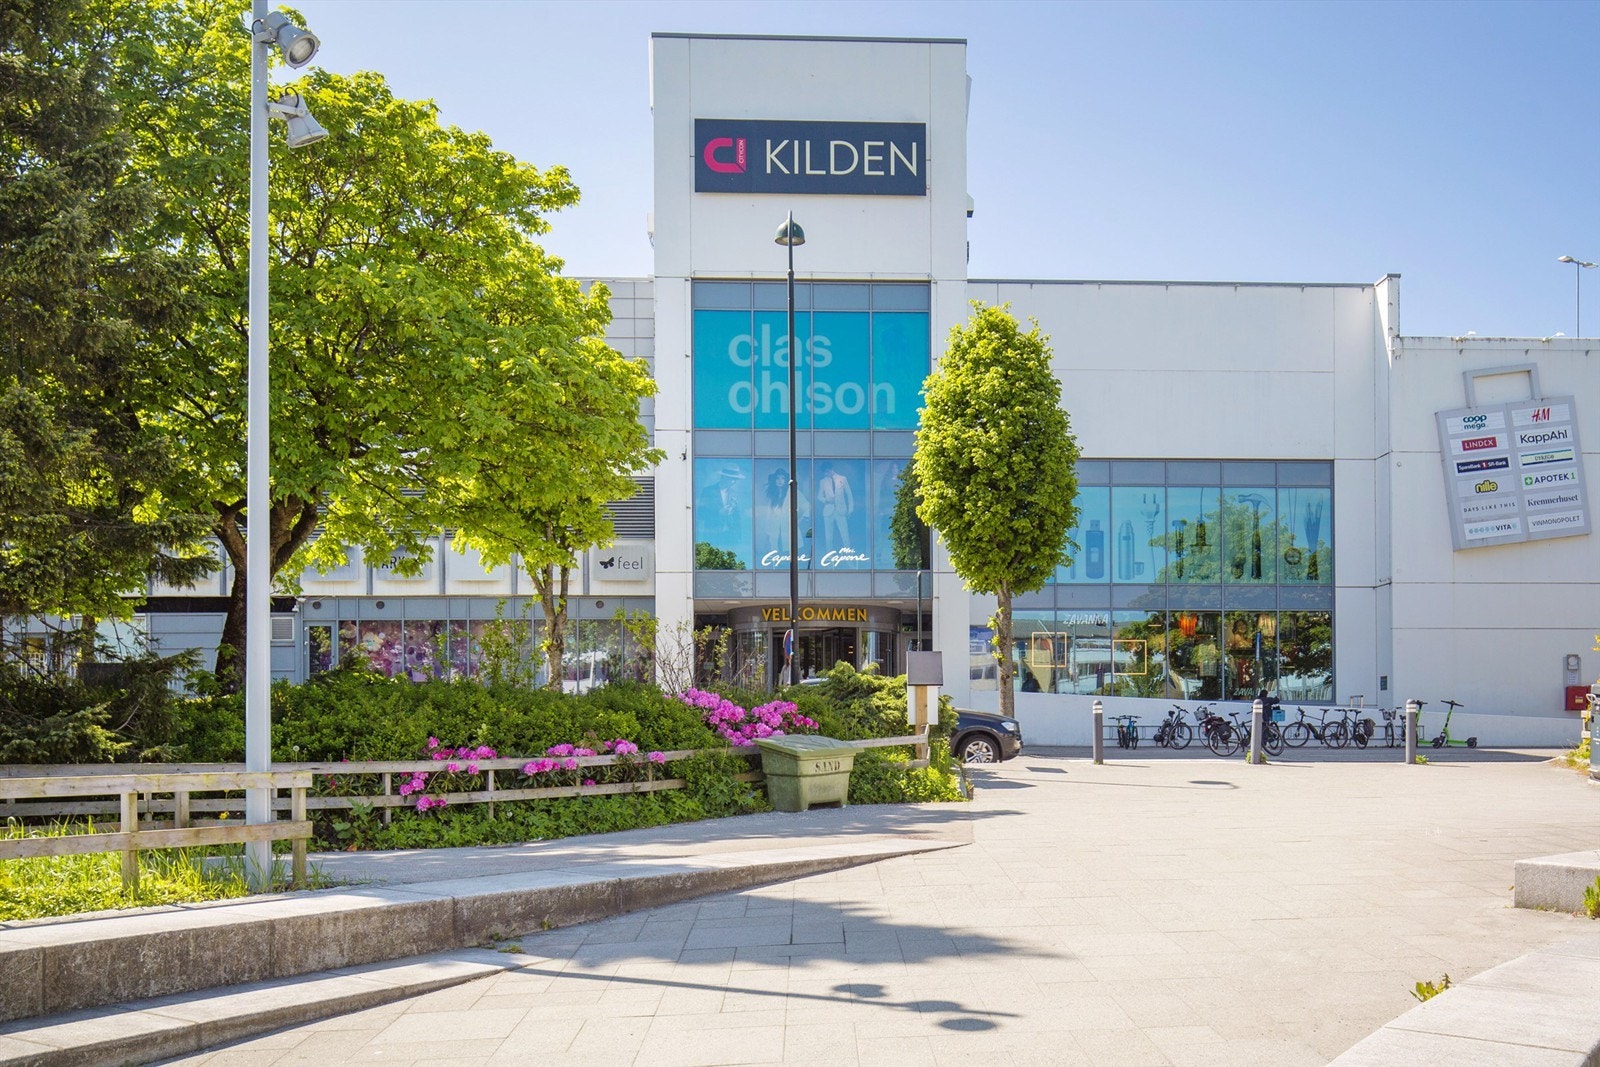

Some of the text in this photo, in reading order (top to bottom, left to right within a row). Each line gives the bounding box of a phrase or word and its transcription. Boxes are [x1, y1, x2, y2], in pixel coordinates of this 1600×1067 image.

[765, 139, 917, 177] KILDEN
[728, 324, 833, 368] clas
[728, 371, 896, 415] ohlson
[1462, 414, 1487, 423] coop
[1531, 407, 1551, 423] H&M
[1463, 422, 1486, 430] mega
[1520, 429, 1568, 444] KappAhl
[1464, 438, 1494, 449] LINDEX
[1534, 474, 1570, 484] APOTEK
[1475, 480, 1498, 493] nille
[1527, 494, 1579, 507] Kremmerhuset
[1531, 515, 1580, 527] VINMONOPOLET
[617, 556, 643, 570] feel
[761, 550, 811, 567] Capoe
[820, 550, 870, 567] Capone
[814, 760, 841, 773] SAND
